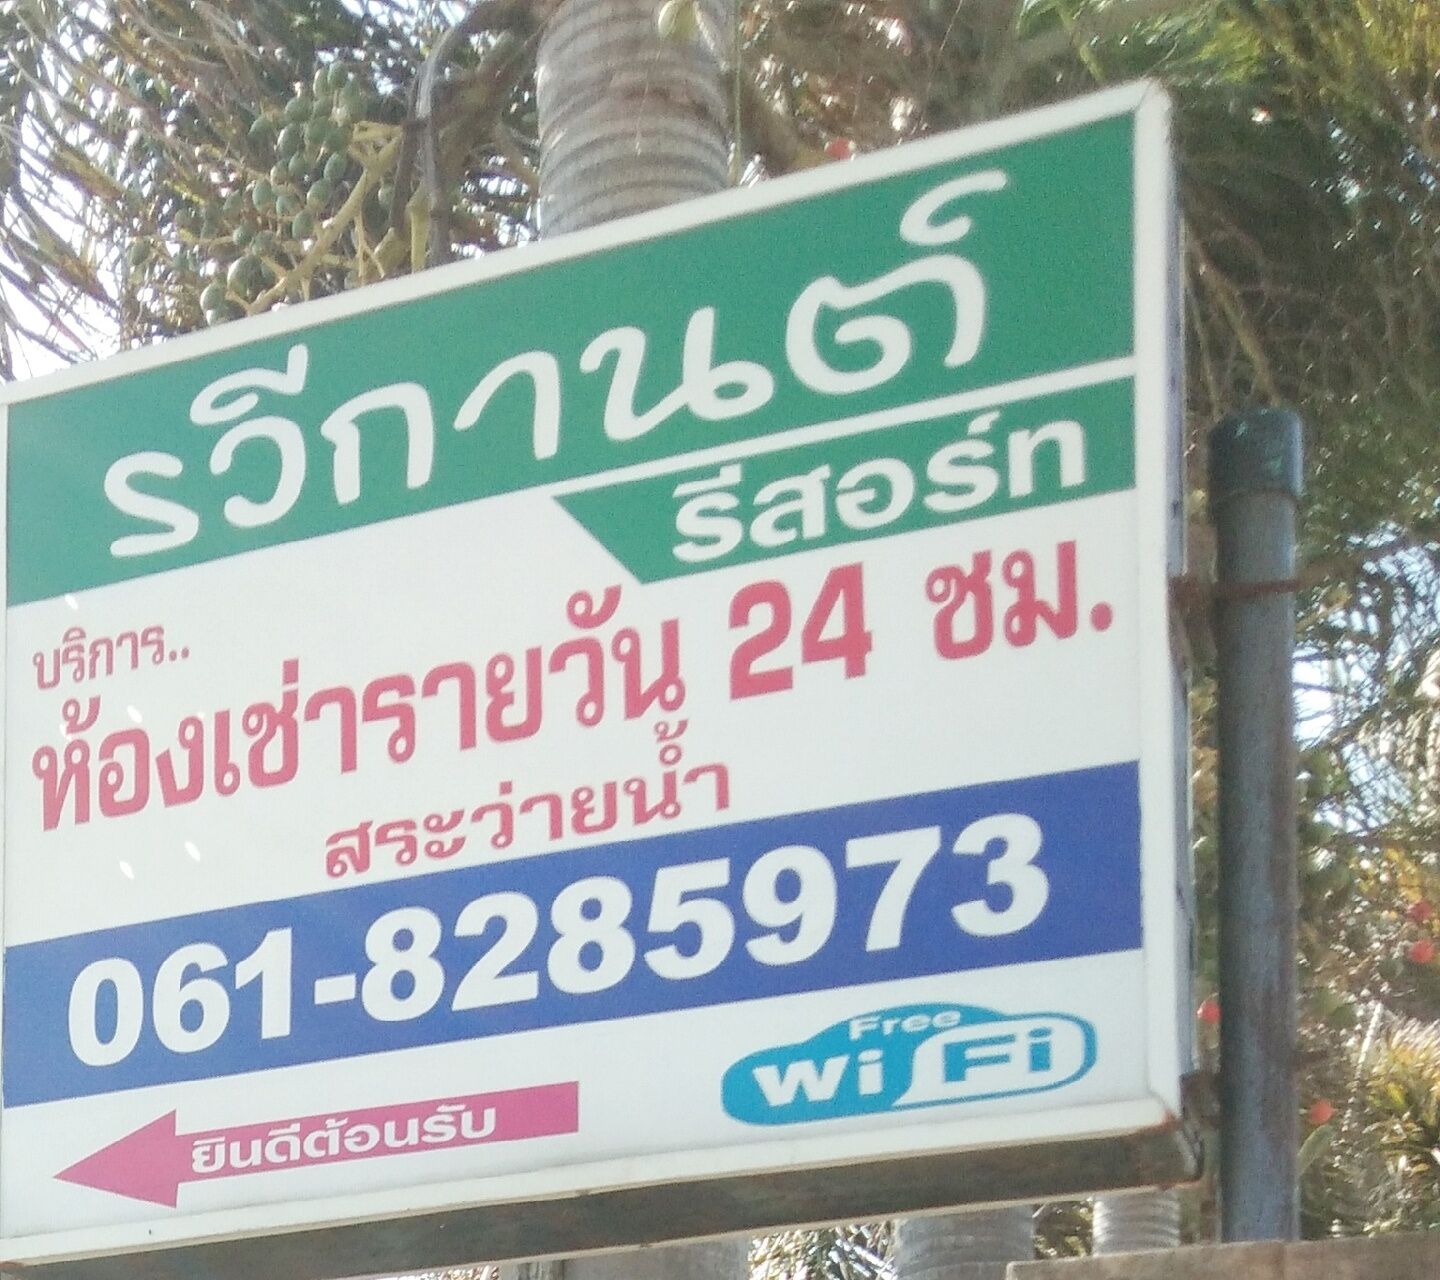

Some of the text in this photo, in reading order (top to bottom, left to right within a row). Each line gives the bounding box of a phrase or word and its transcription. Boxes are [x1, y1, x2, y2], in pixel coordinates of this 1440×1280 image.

[103, 169, 1009, 558] รวีกานต์
[672, 411, 1086, 563] รีสอร์ท
[32, 540, 1114, 831] ห้องเช่ารายวัน 24 ชม.
[325, 719, 730, 878] สระว่ายน้ำ
[68, 813, 1050, 1067] 061-8285973
[849, 1010, 962, 1041] Free
[191, 1103, 497, 1174] ยินดีต้อนรับ
